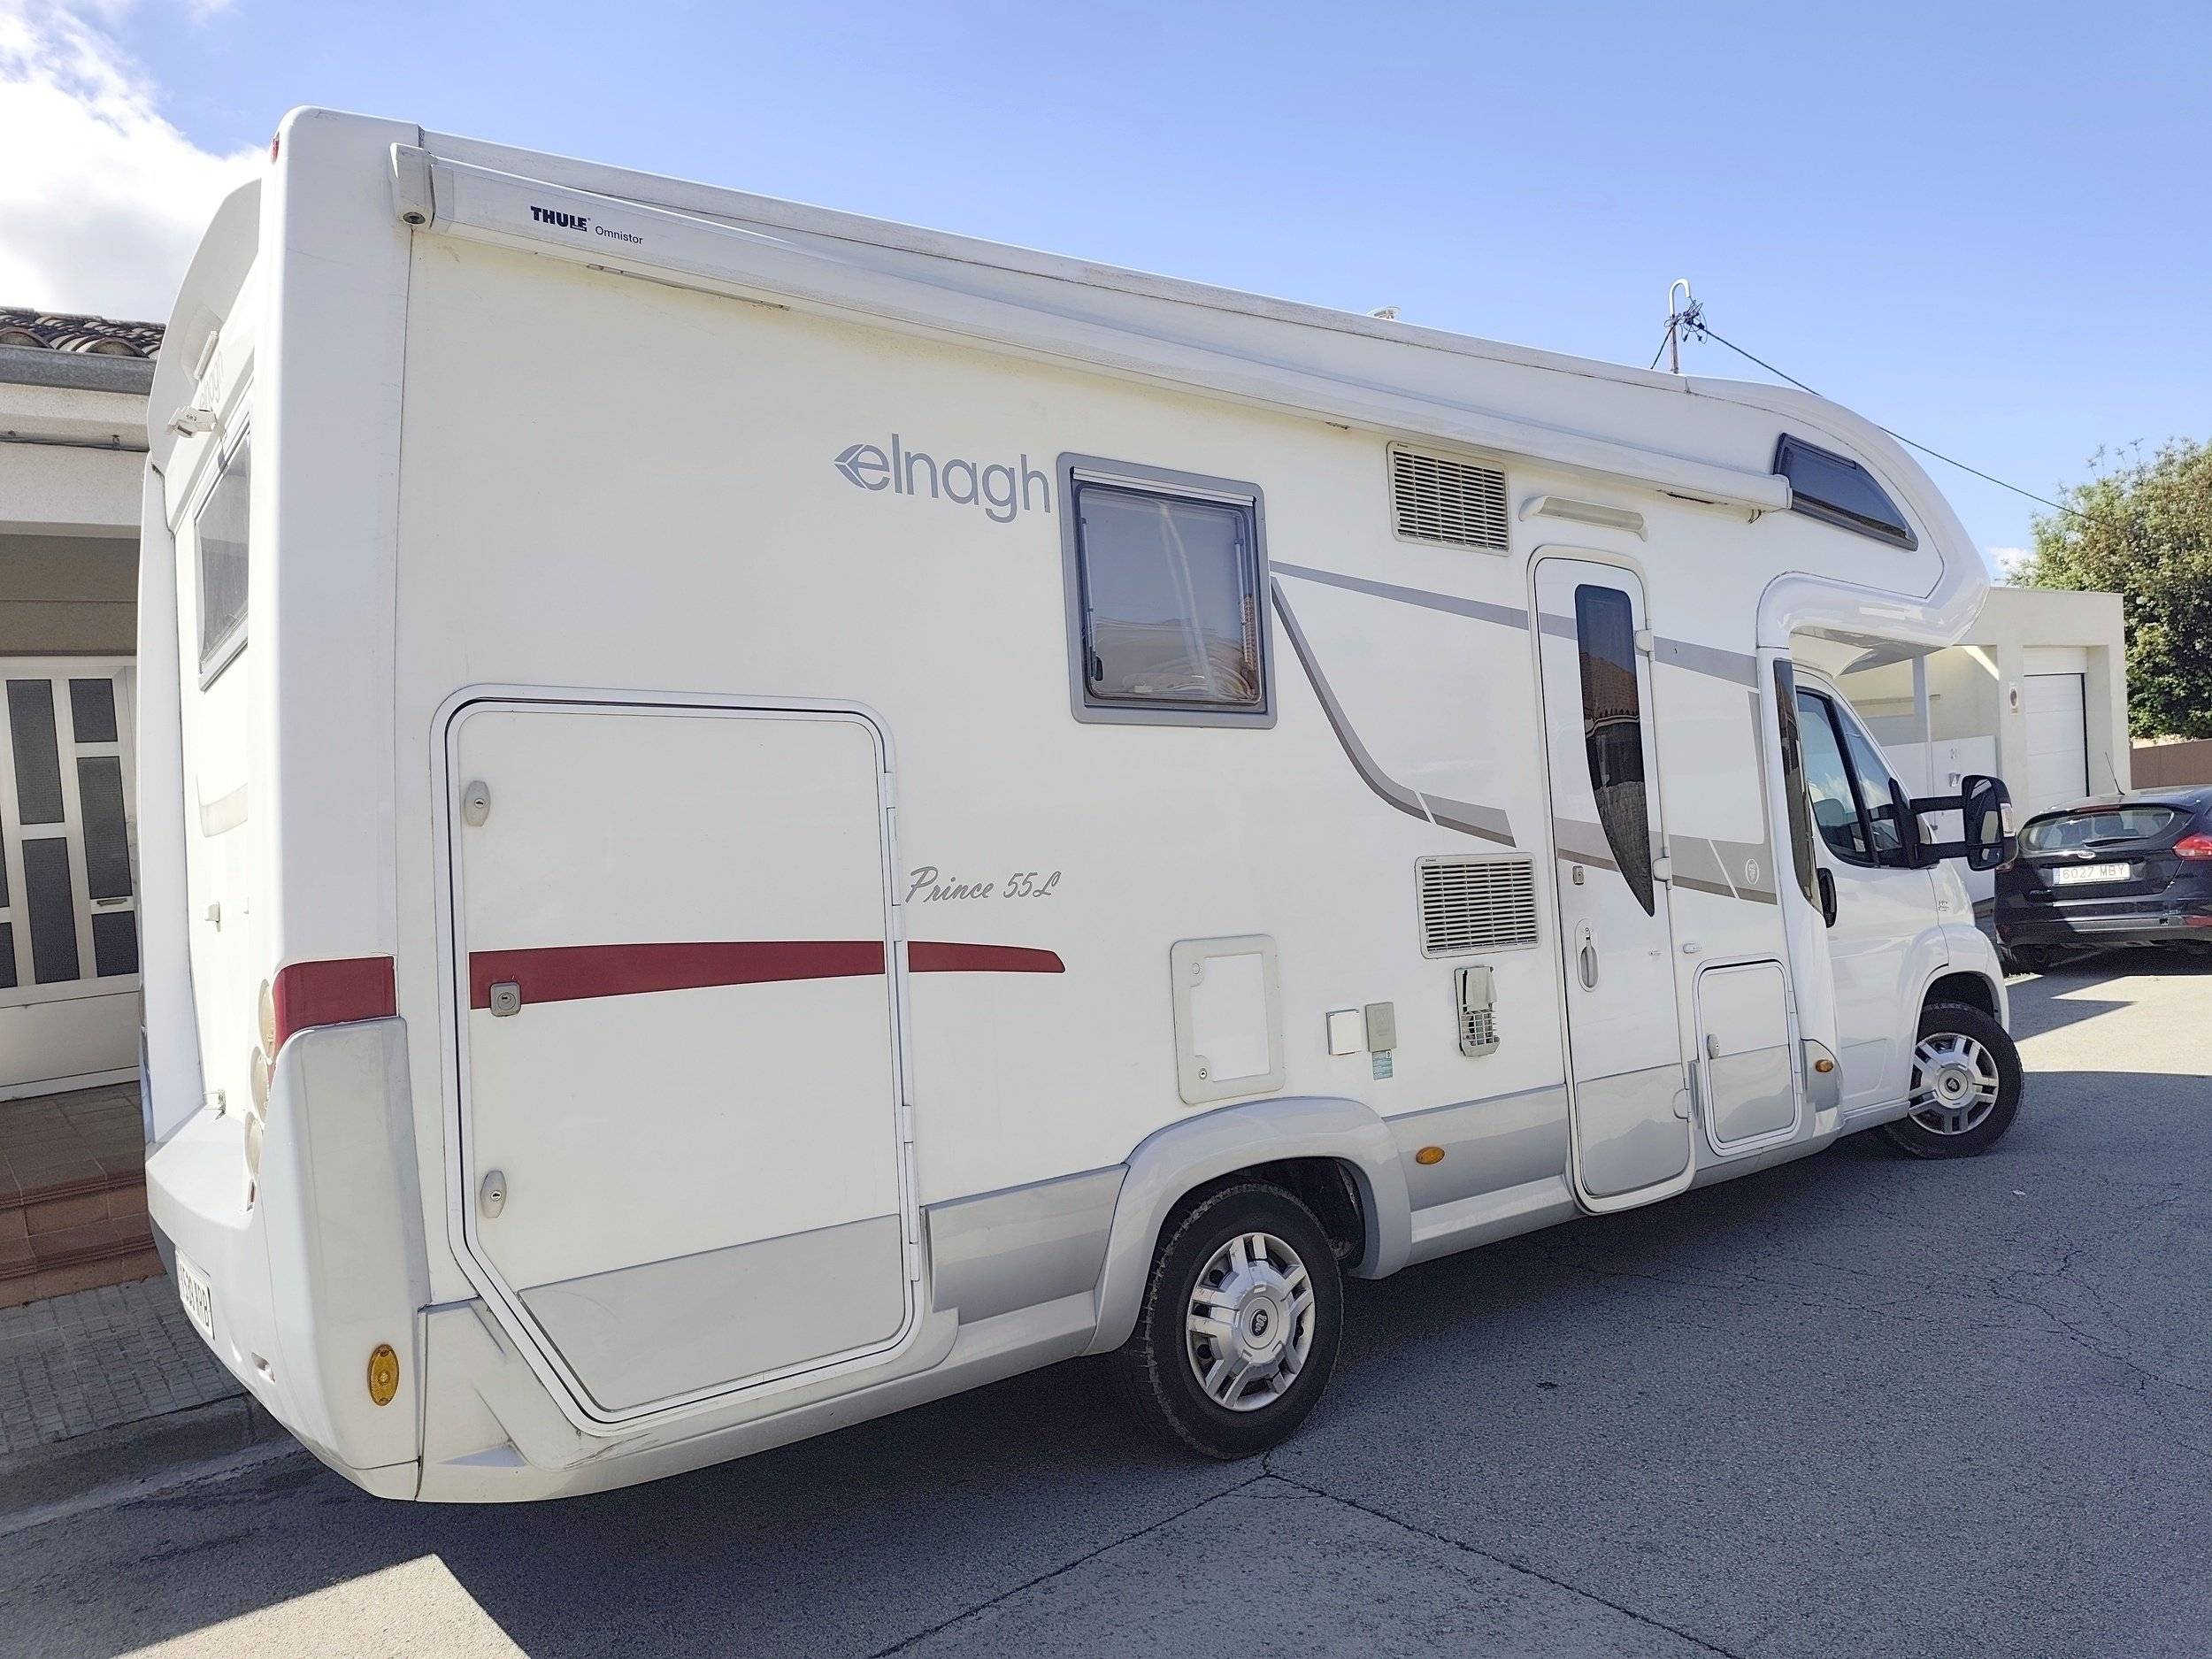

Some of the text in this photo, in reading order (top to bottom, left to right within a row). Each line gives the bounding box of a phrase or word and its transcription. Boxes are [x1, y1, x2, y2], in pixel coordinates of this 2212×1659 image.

[531, 205, 643, 245] THULE Omnistor
[833, 433, 1051, 523] elnagh
[905, 865, 1062, 903] Prince 55L
[2062, 866, 2093, 879] 6027
